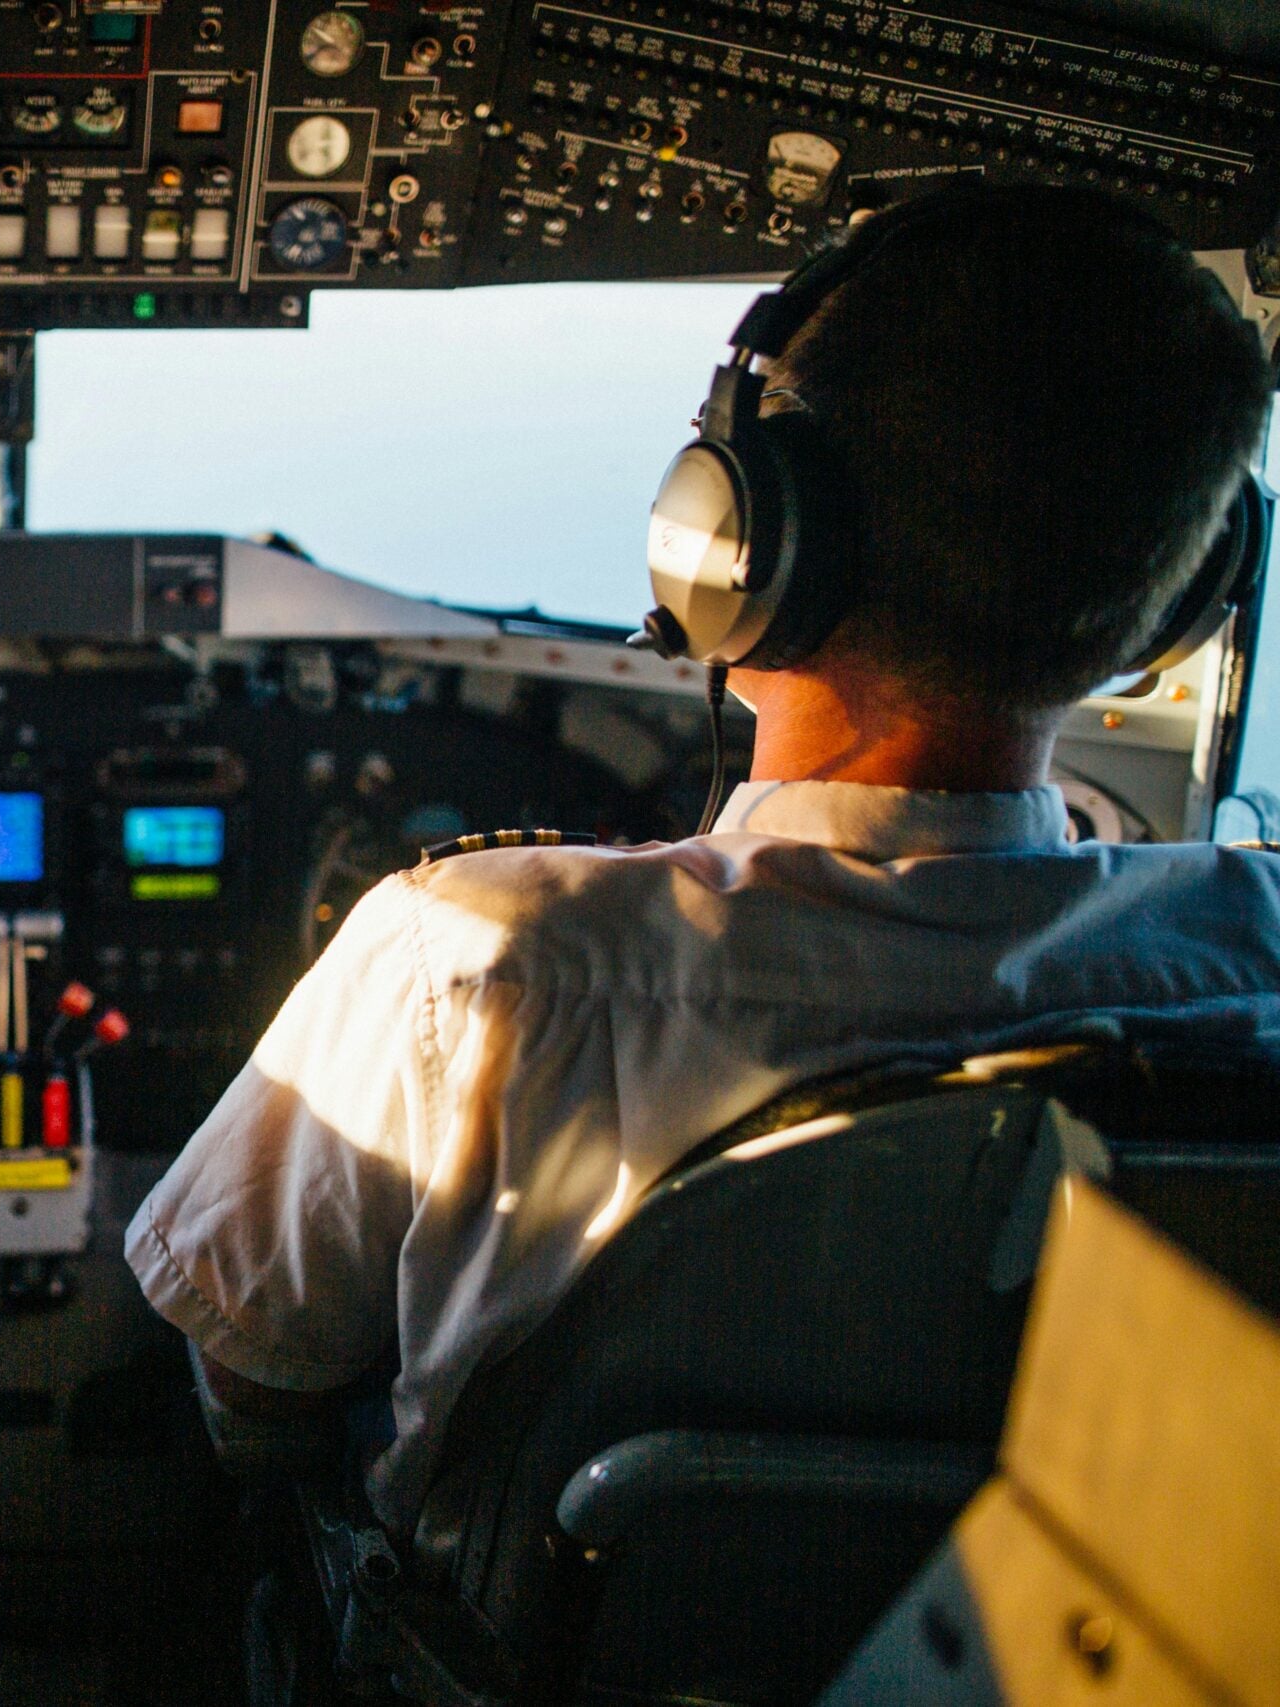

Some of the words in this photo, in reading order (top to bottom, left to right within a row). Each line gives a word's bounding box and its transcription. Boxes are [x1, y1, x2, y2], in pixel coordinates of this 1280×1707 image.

[798, 55, 818, 67] GEN
[819, 60, 839, 72] BUS
[1063, 62, 1082, 72] COM
[1113, 49, 1137, 61] LEFT
[1137, 53, 1180, 70] AVIONICS
[1180, 62, 1200, 73] BUS
[1089, 67, 1118, 79] PILOTS
[1035, 116, 1062, 129] RIGHT
[1062, 122, 1104, 138] AVIONICS
[1104, 130, 1124, 142] BUS
[914, 165, 958, 177] LIGHTING
